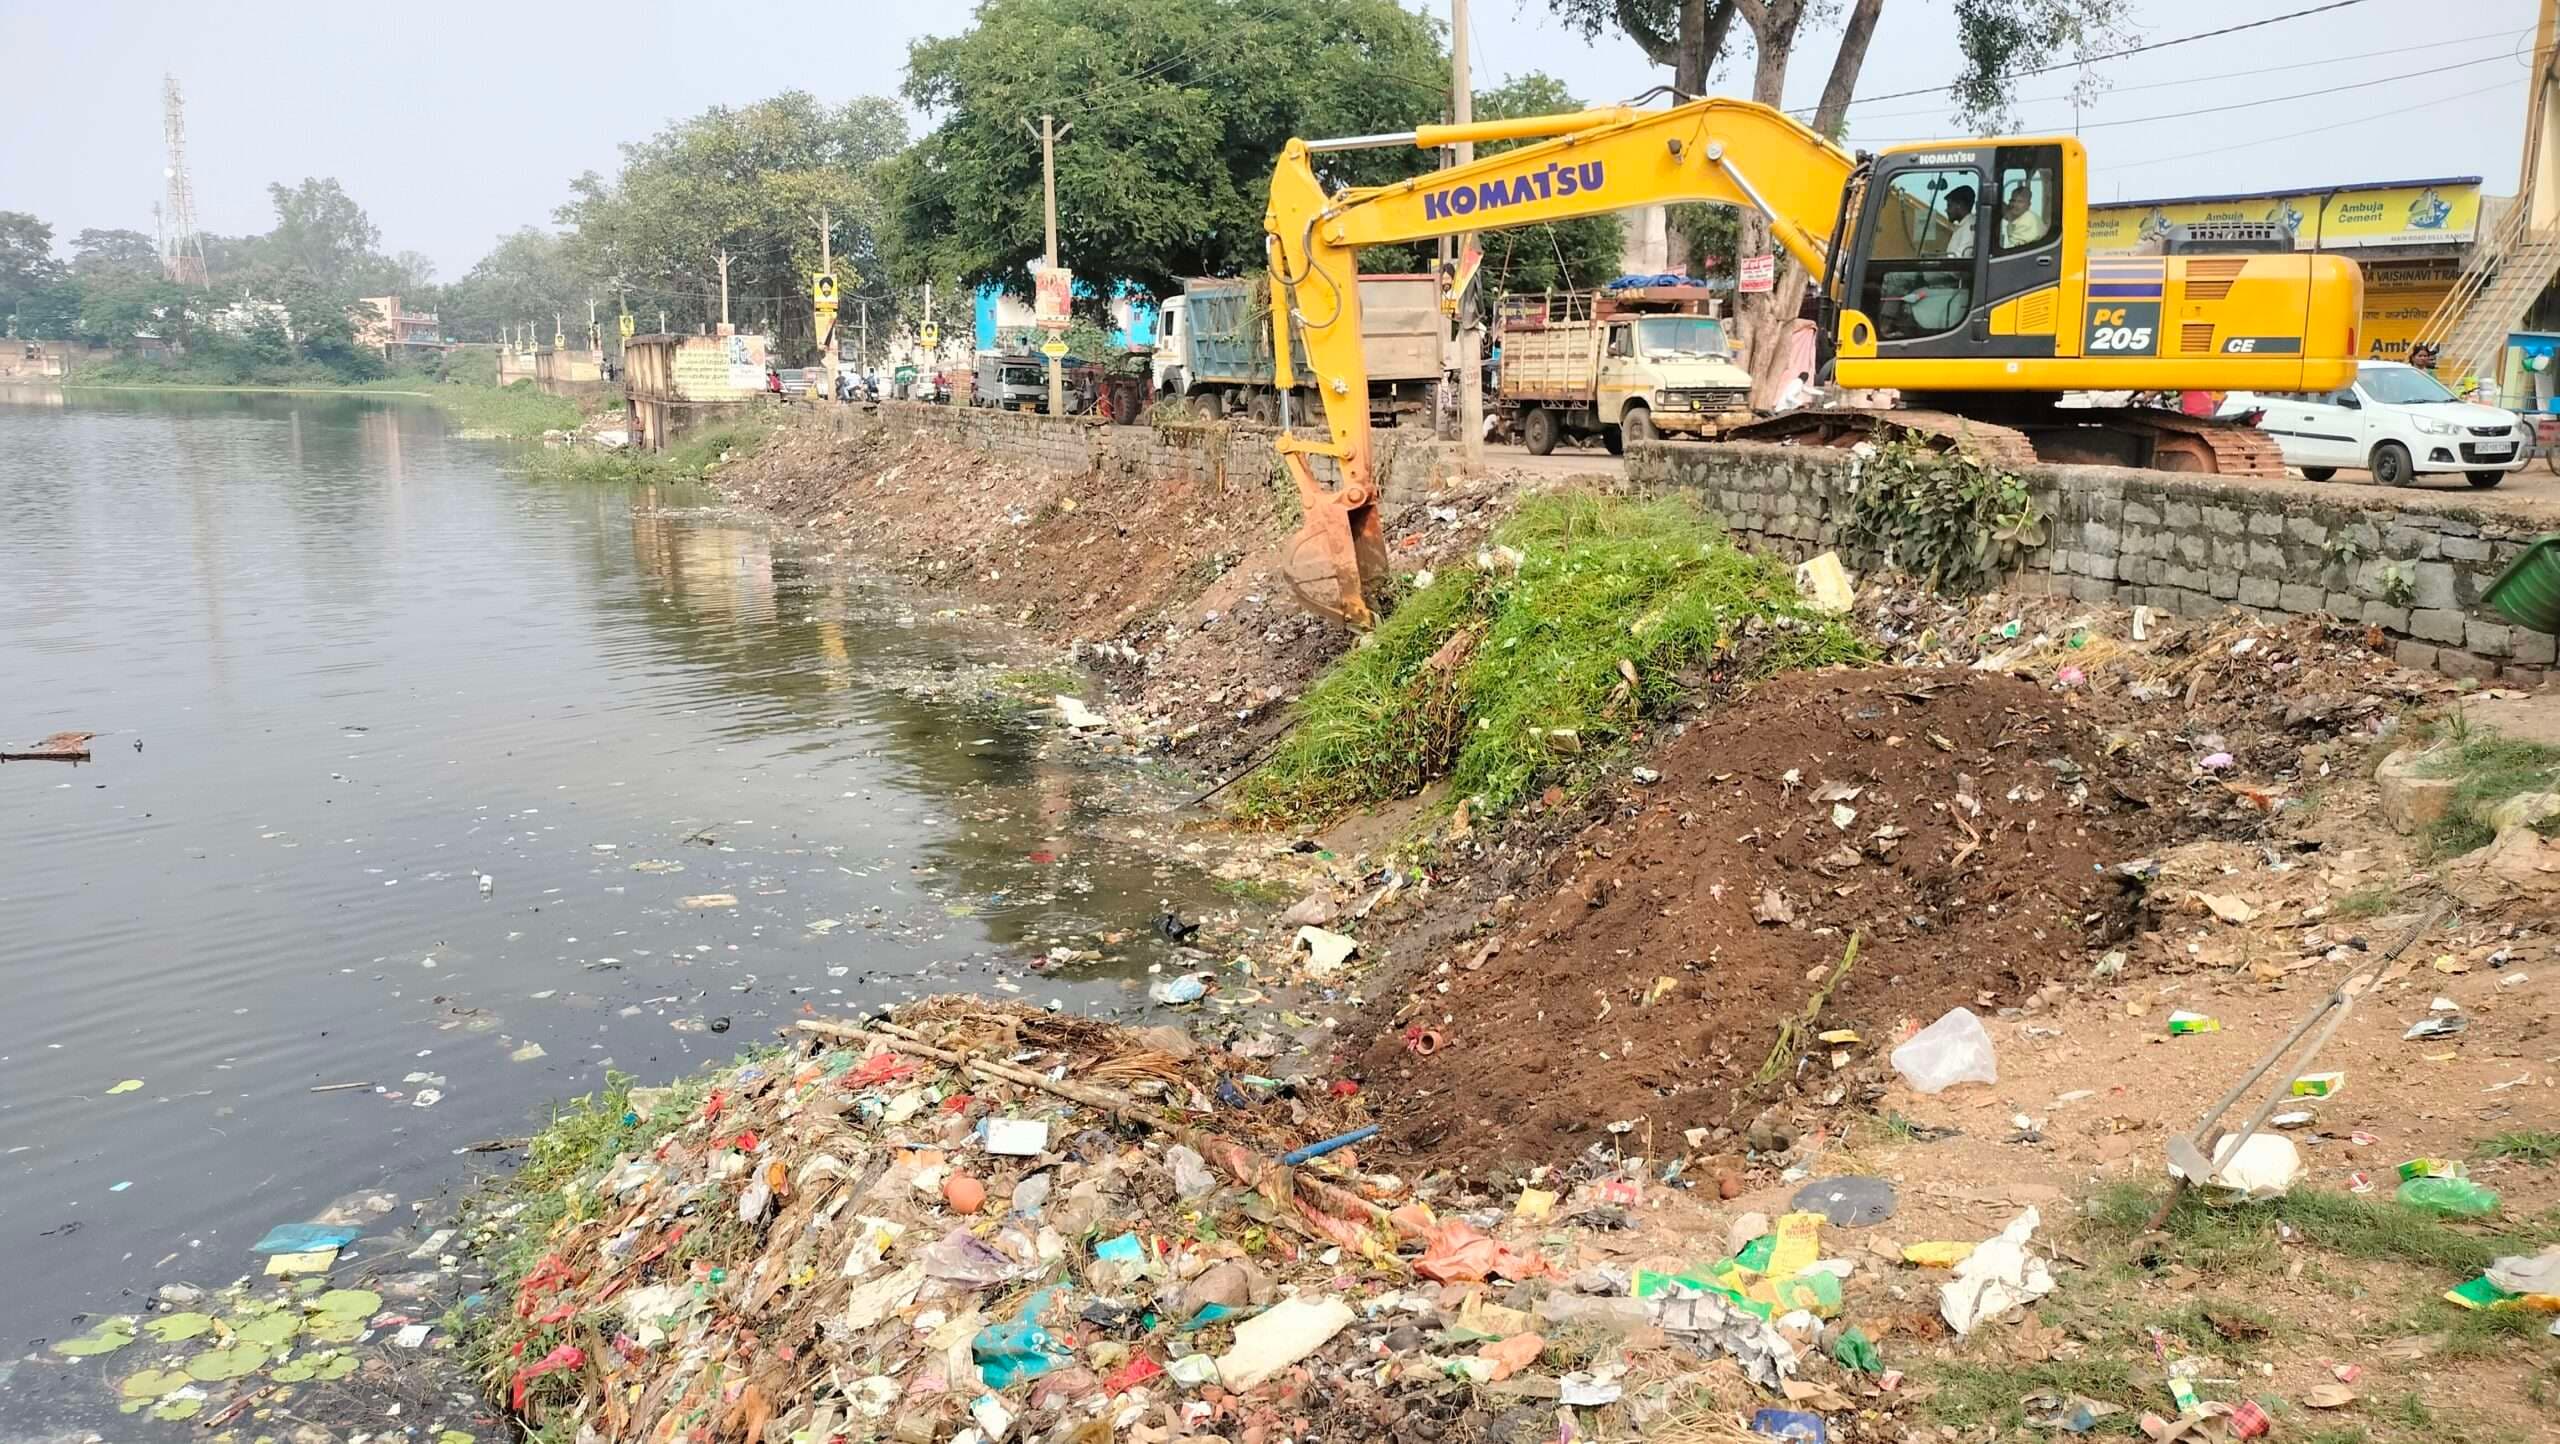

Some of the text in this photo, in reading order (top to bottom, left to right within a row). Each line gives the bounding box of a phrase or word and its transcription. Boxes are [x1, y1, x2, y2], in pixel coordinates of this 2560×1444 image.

[1919, 151, 1976, 165] KOMATSU
[1424, 160, 1604, 221] KOMATSU
[2340, 202, 2384, 213] Ambuja
[2338, 213, 2383, 224] Cement
[2086, 229, 2119, 238] ement
[2377, 270, 2432, 281] VAISHNAVI
[2093, 308, 2127, 326] PC
[2090, 327, 2153, 350] 205
[2228, 338, 2256, 353] CE
